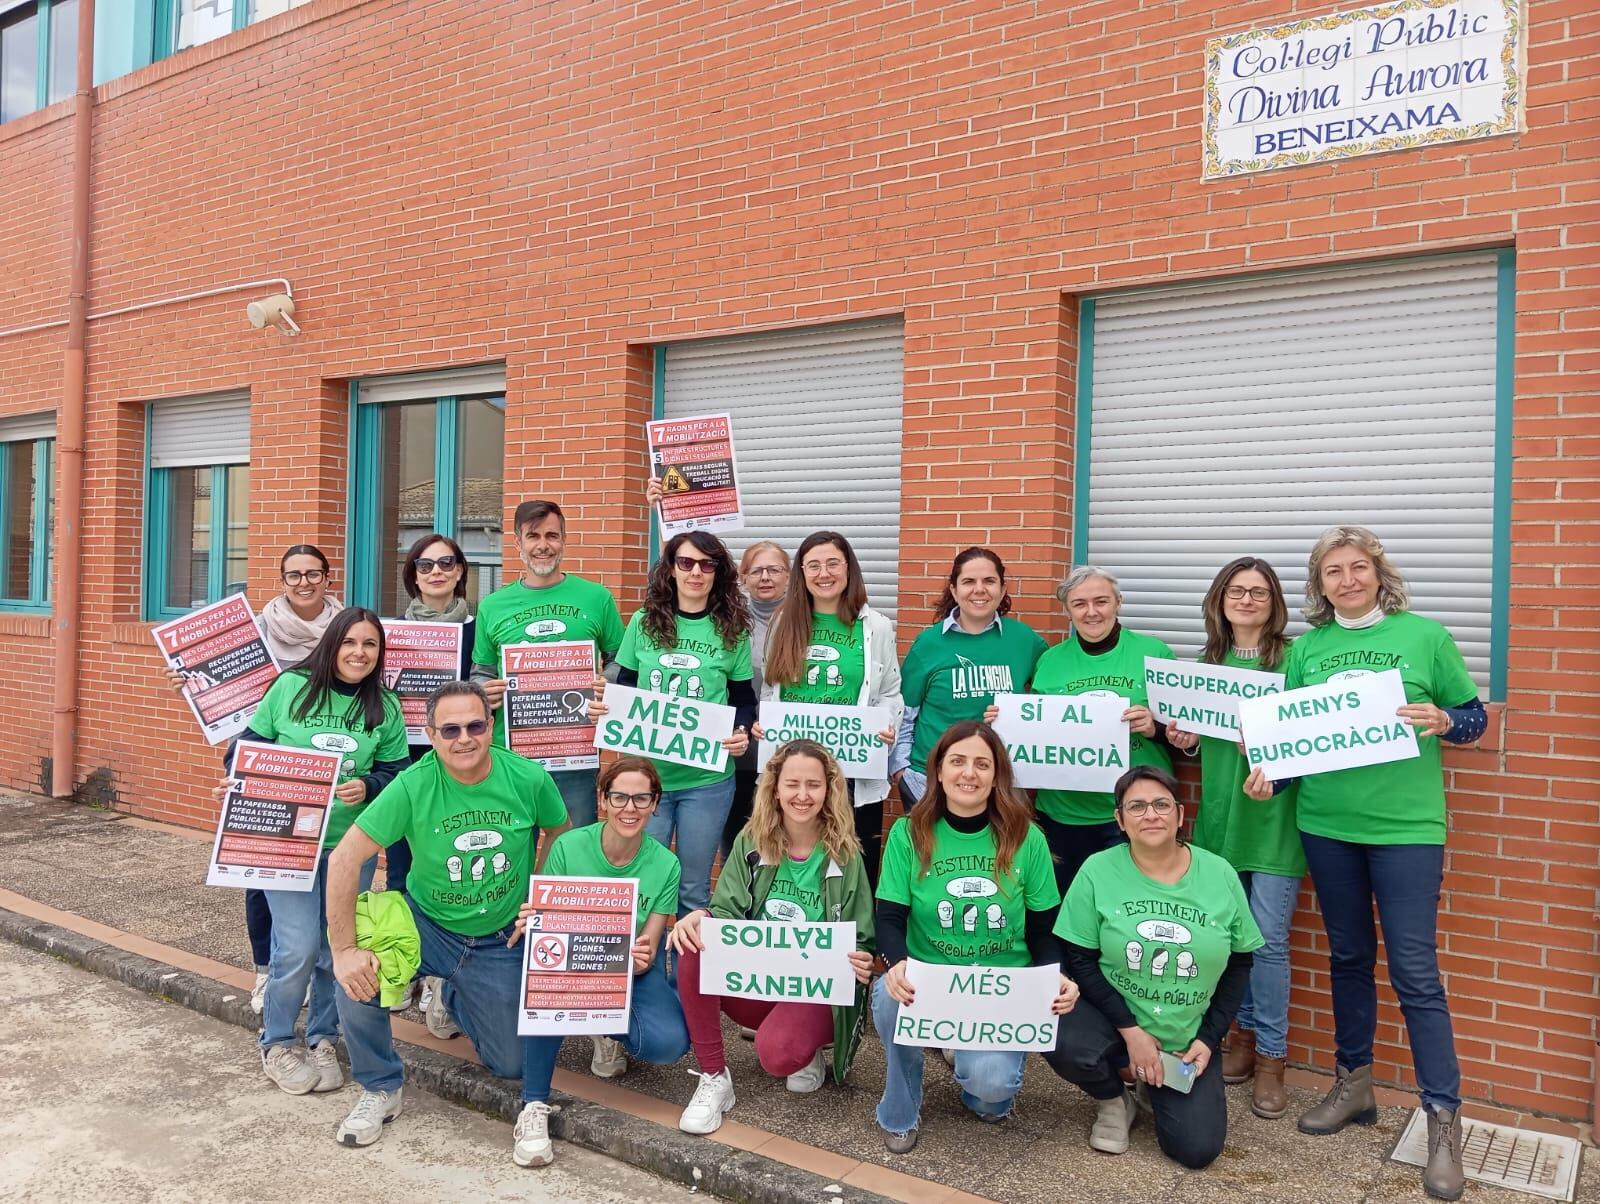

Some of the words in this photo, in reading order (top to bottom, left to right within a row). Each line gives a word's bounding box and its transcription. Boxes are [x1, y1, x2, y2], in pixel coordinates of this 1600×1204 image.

[1366, 9, 1488, 54] Públic
[1228, 84, 1340, 125] Divina
[1362, 56, 1488, 100] Aurora
[1254, 102, 1461, 155] BENEIXAMA
[654, 428, 665, 442] 7
[667, 423, 692, 432] RAONS
[667, 429, 726, 442] MOBILITZACIÓ
[656, 454, 662, 462] 5
[178, 616, 208, 635] RAONS
[208, 610, 224, 623] PER
[232, 602, 243, 612] LA
[513, 604, 580, 624] ESTIMEM
[180, 610, 248, 644] MOBILITZACIÓ
[163, 629, 179, 649] 7
[390, 639, 455, 647] MOBILITZACIÓ
[175, 659, 181, 667] 1
[207, 645, 251, 668] RECUPEREM
[250, 641, 260, 649] EL
[211, 658, 240, 675] NOSTRE
[240, 648, 264, 663] PODER
[509, 653, 522, 669] 7
[523, 657, 593, 669] MOBILITZACIÓ
[1320, 650, 1402, 671] ESTIMEM
[220, 655, 266, 679] ADQUISITIU!
[509, 679, 516, 688] 6
[952, 668, 966, 692] LA
[968, 665, 1013, 691] LLENGUA
[1066, 675, 1135, 692] ESTIMEM
[1146, 669, 1280, 698] RECUPERACIÓ
[628, 697, 700, 731] MÉS
[1021, 699, 1043, 721] SÍ
[1061, 705, 1092, 723] AL
[1278, 692, 1360, 722] MENYS
[783, 714, 861, 731] MILLORS
[603, 720, 721, 765] SALARI
[766, 729, 883, 748] CONDICIONS
[1250, 722, 1409, 764] BUROCRÀCIA
[242, 750, 258, 769] 7
[259, 753, 293, 763] RAONS
[295, 758, 312, 766] PER
[233, 780, 242, 791] 4
[246, 785, 280, 796] L'ESCOLA
[282, 790, 292, 798] NO
[294, 791, 308, 799] POT
[247, 778, 268, 787] PROU
[231, 805, 256, 815] OFEGA
[257, 808, 291, 819] L'ESCOLA
[243, 799, 286, 811] PAPERASSA
[227, 820, 281, 834] PROFESSORAT
[229, 812, 261, 823] PÚBLICA
[275, 818, 290, 826] SEU
[442, 810, 512, 834] ESTIMEM
[933, 855, 1008, 876] ESTIME
[432, 889, 483, 905] L'ESCOLA
[486, 872, 520, 903] PÚBLICA
[538, 885, 553, 904] 7
[555, 886, 588, 894] RAONS
[552, 897, 629, 907] MOBILITZACIÓ
[533, 917, 540, 927] 2
[1122, 900, 1208, 927] ESTIMEM
[573, 936, 621, 944] PLANTILLES
[573, 945, 606, 953] DIGNES,
[721, 924, 832, 959] RÀTIOS
[726, 971, 833, 998] MENYS
[949, 968, 1010, 996] MÉS
[1110, 968, 1161, 1001] L'ESCOLA
[897, 1016, 1053, 1044] RECURSOS
